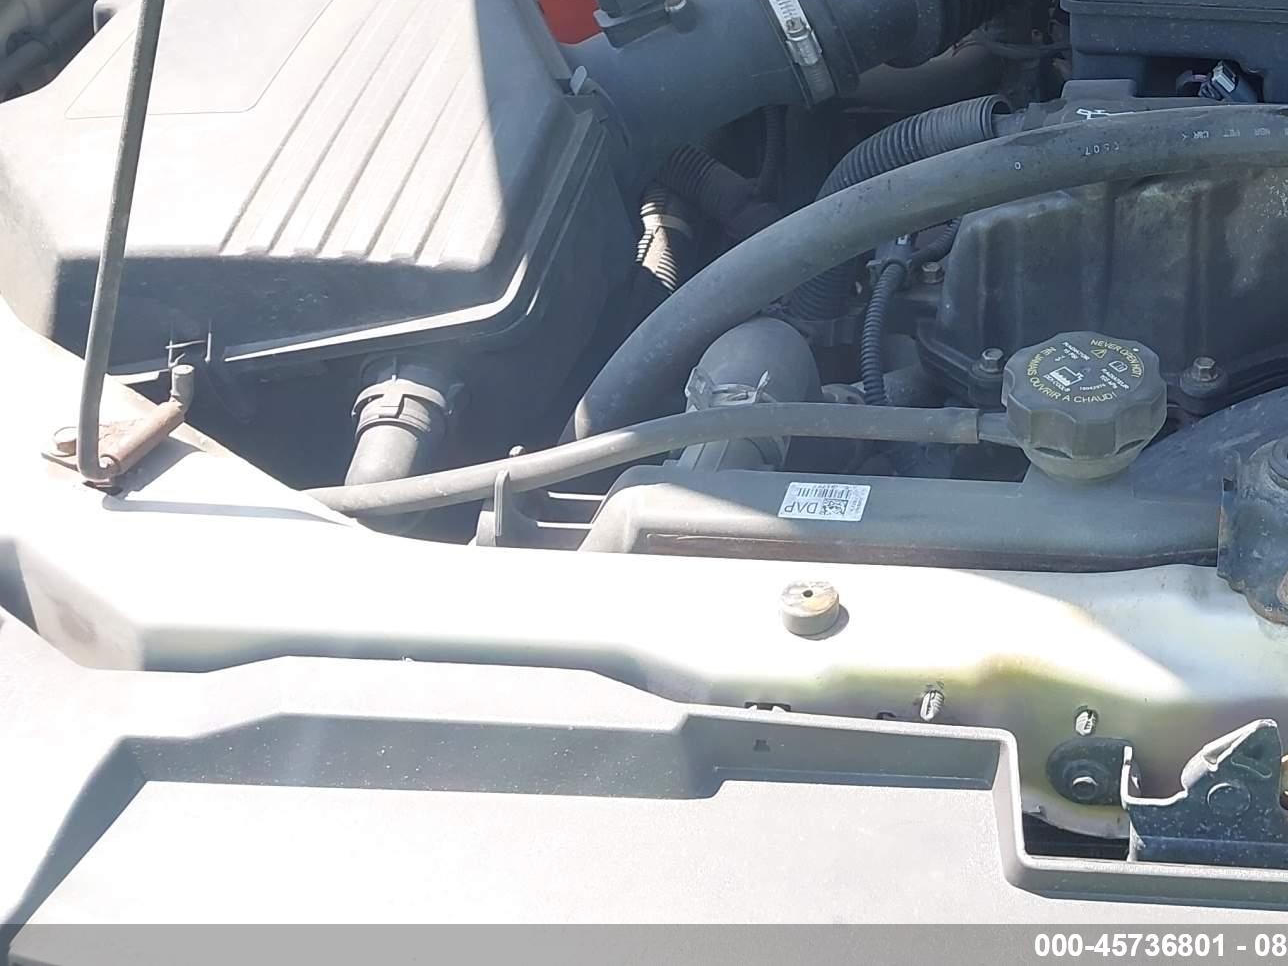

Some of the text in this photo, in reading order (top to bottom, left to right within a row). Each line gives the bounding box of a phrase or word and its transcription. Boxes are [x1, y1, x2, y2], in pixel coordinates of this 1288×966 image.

[1040, 346, 1056, 356] NE
[1062, 342, 1090, 361] RADIATOR
[1090, 339, 1121, 352] NEVER
[1120, 348, 1138, 365] OPEN
[1030, 377, 1061, 399] OUVRIR
[1101, 368, 1130, 389] RADIATEUR
[1074, 392, 1118, 403] CHAUD!
[784, 502, 818, 514] DAP
